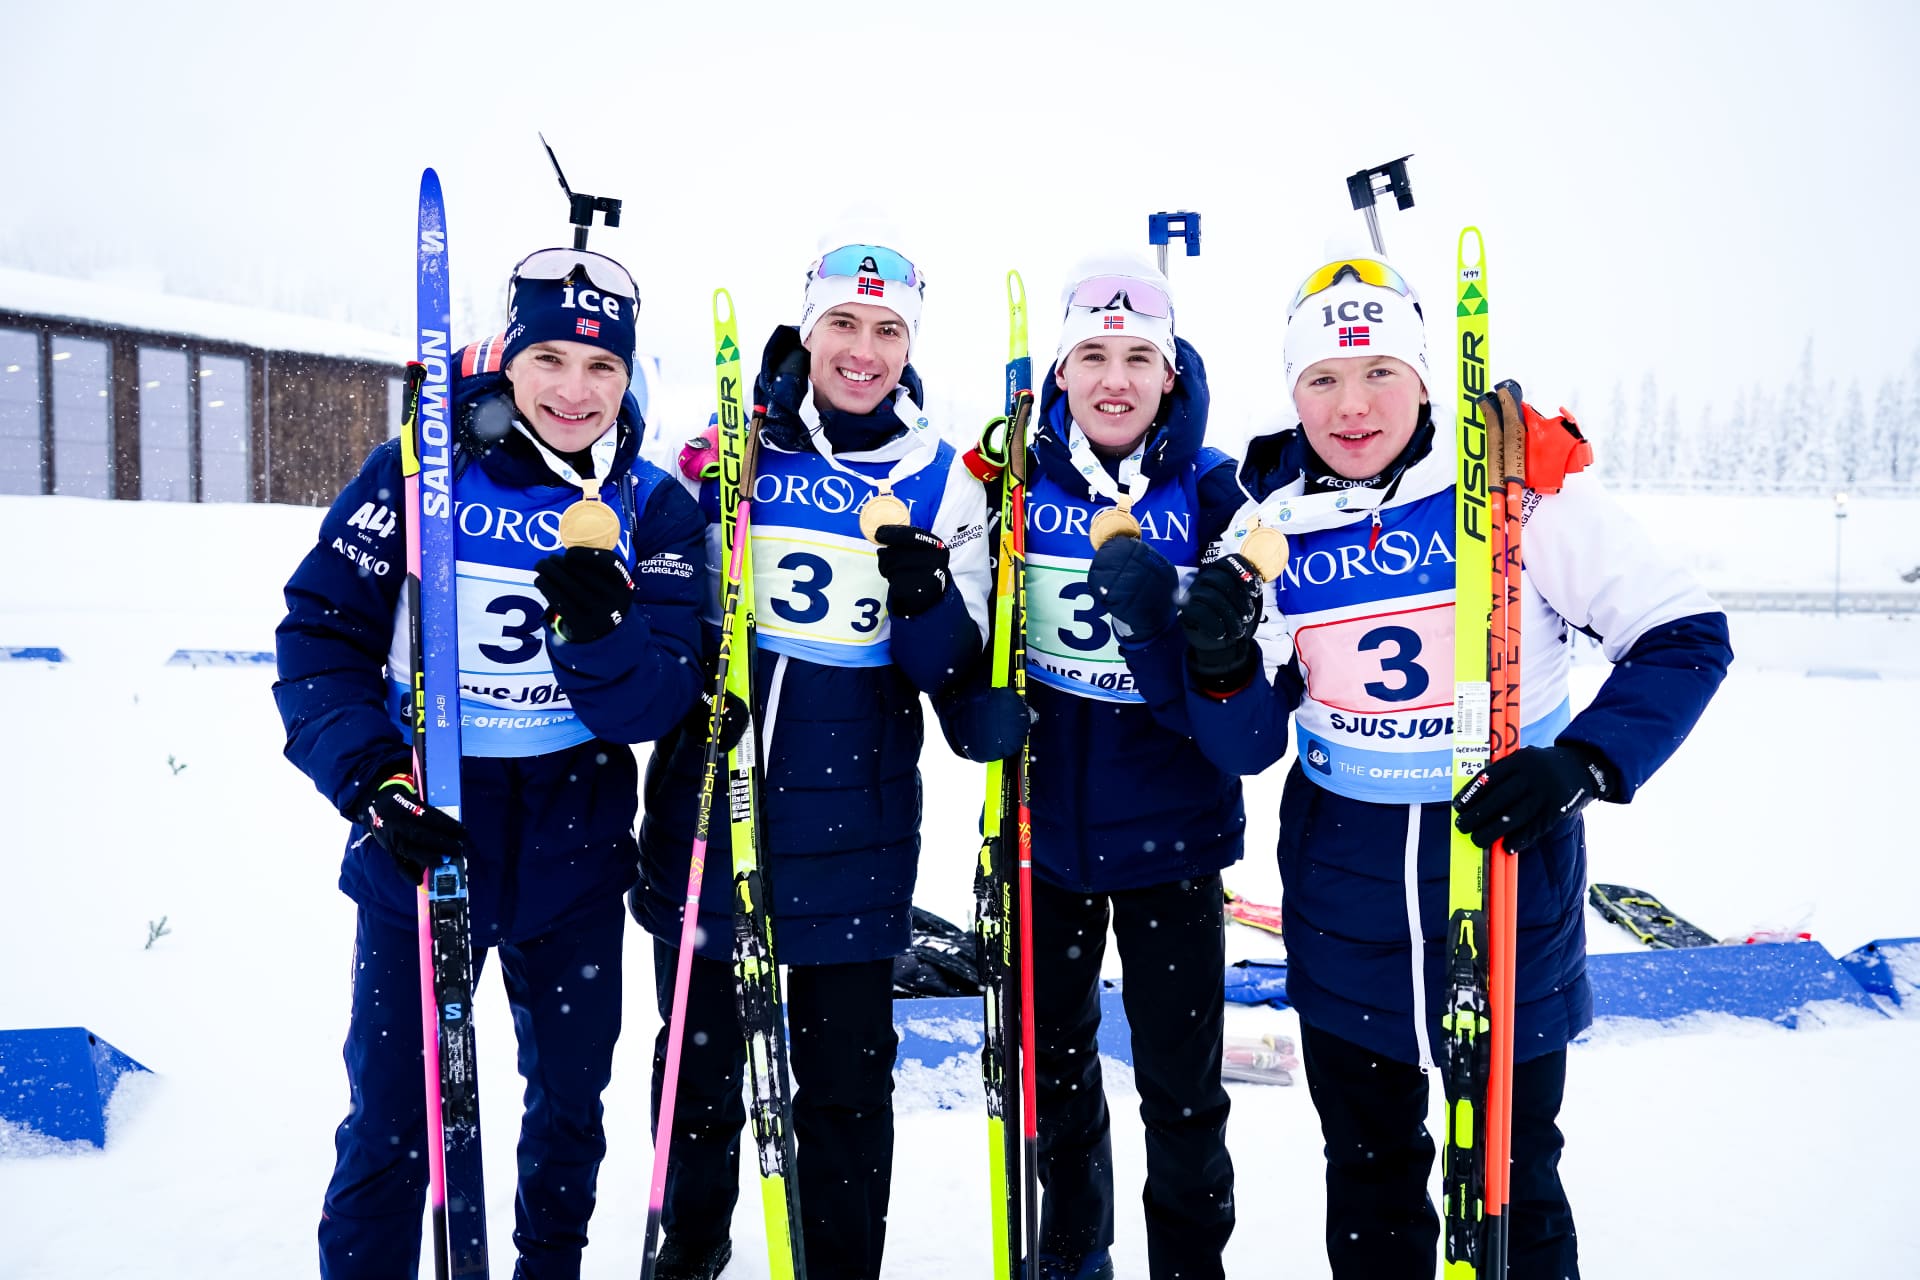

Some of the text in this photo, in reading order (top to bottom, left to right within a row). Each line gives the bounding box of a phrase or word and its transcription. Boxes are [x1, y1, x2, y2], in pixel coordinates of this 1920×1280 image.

[561, 281, 620, 321] ice
[1321, 301, 1384, 327] ice
[421, 328, 451, 520] SALOMON
[1462, 330, 1487, 544] FISCHER
[720, 376, 741, 552] FISCHER
[638, 560, 694, 573] HURTIGRUTA
[769, 552, 833, 624] 3
[850, 597, 881, 632] 3
[1280, 530, 1457, 592] NORSA
[478, 594, 543, 664] 3
[720, 594, 738, 660] LEKI
[1058, 582, 1112, 651] 3
[1357, 625, 1430, 702] 3
[415, 671, 426, 733] LEKI
[1338, 761, 1454, 779] THE OFFICIAL
[1003, 881, 1011, 967] FISCHER
